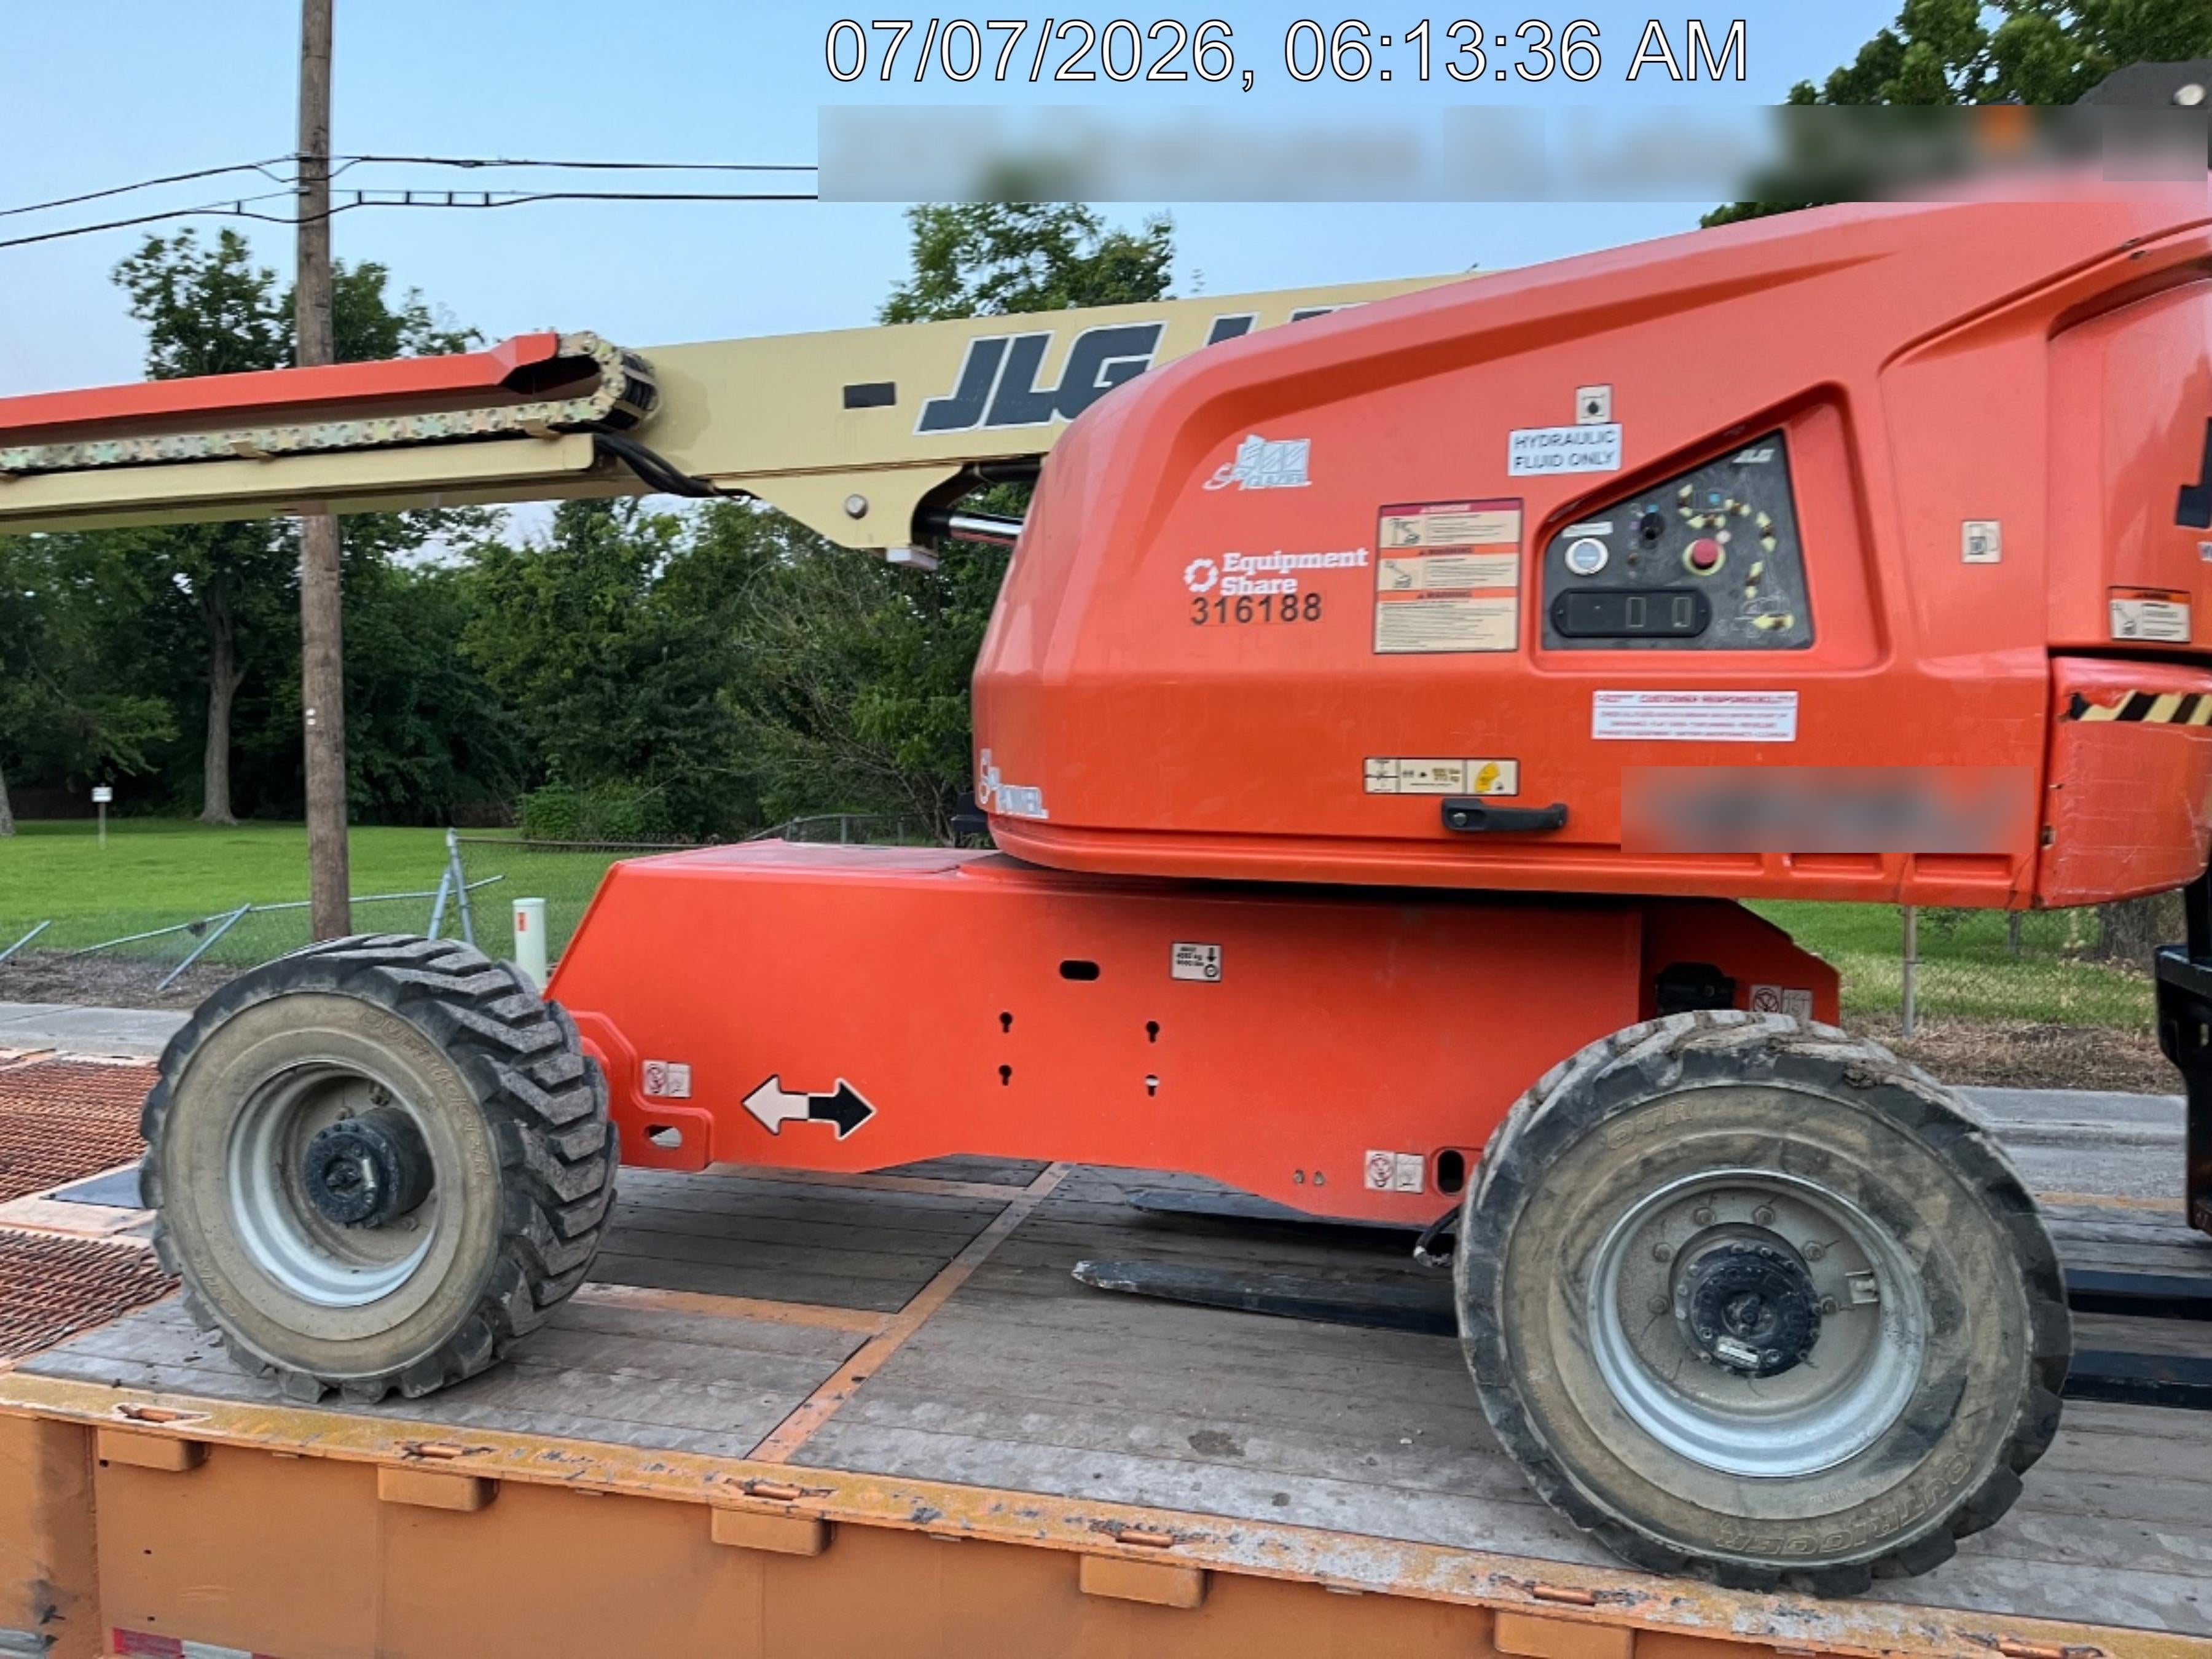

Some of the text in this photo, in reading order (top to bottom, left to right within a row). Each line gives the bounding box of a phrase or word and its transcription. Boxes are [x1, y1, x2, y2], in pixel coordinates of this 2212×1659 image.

[912, 321, 1169, 435] JLG
[1513, 430, 1616, 449] HYDRAULIC
[1513, 450, 1616, 471] FLUID ONLY
[1222, 547, 1370, 576] Equipment
[1220, 576, 1298, 596] Share
[1191, 592, 1322, 626] 316188
